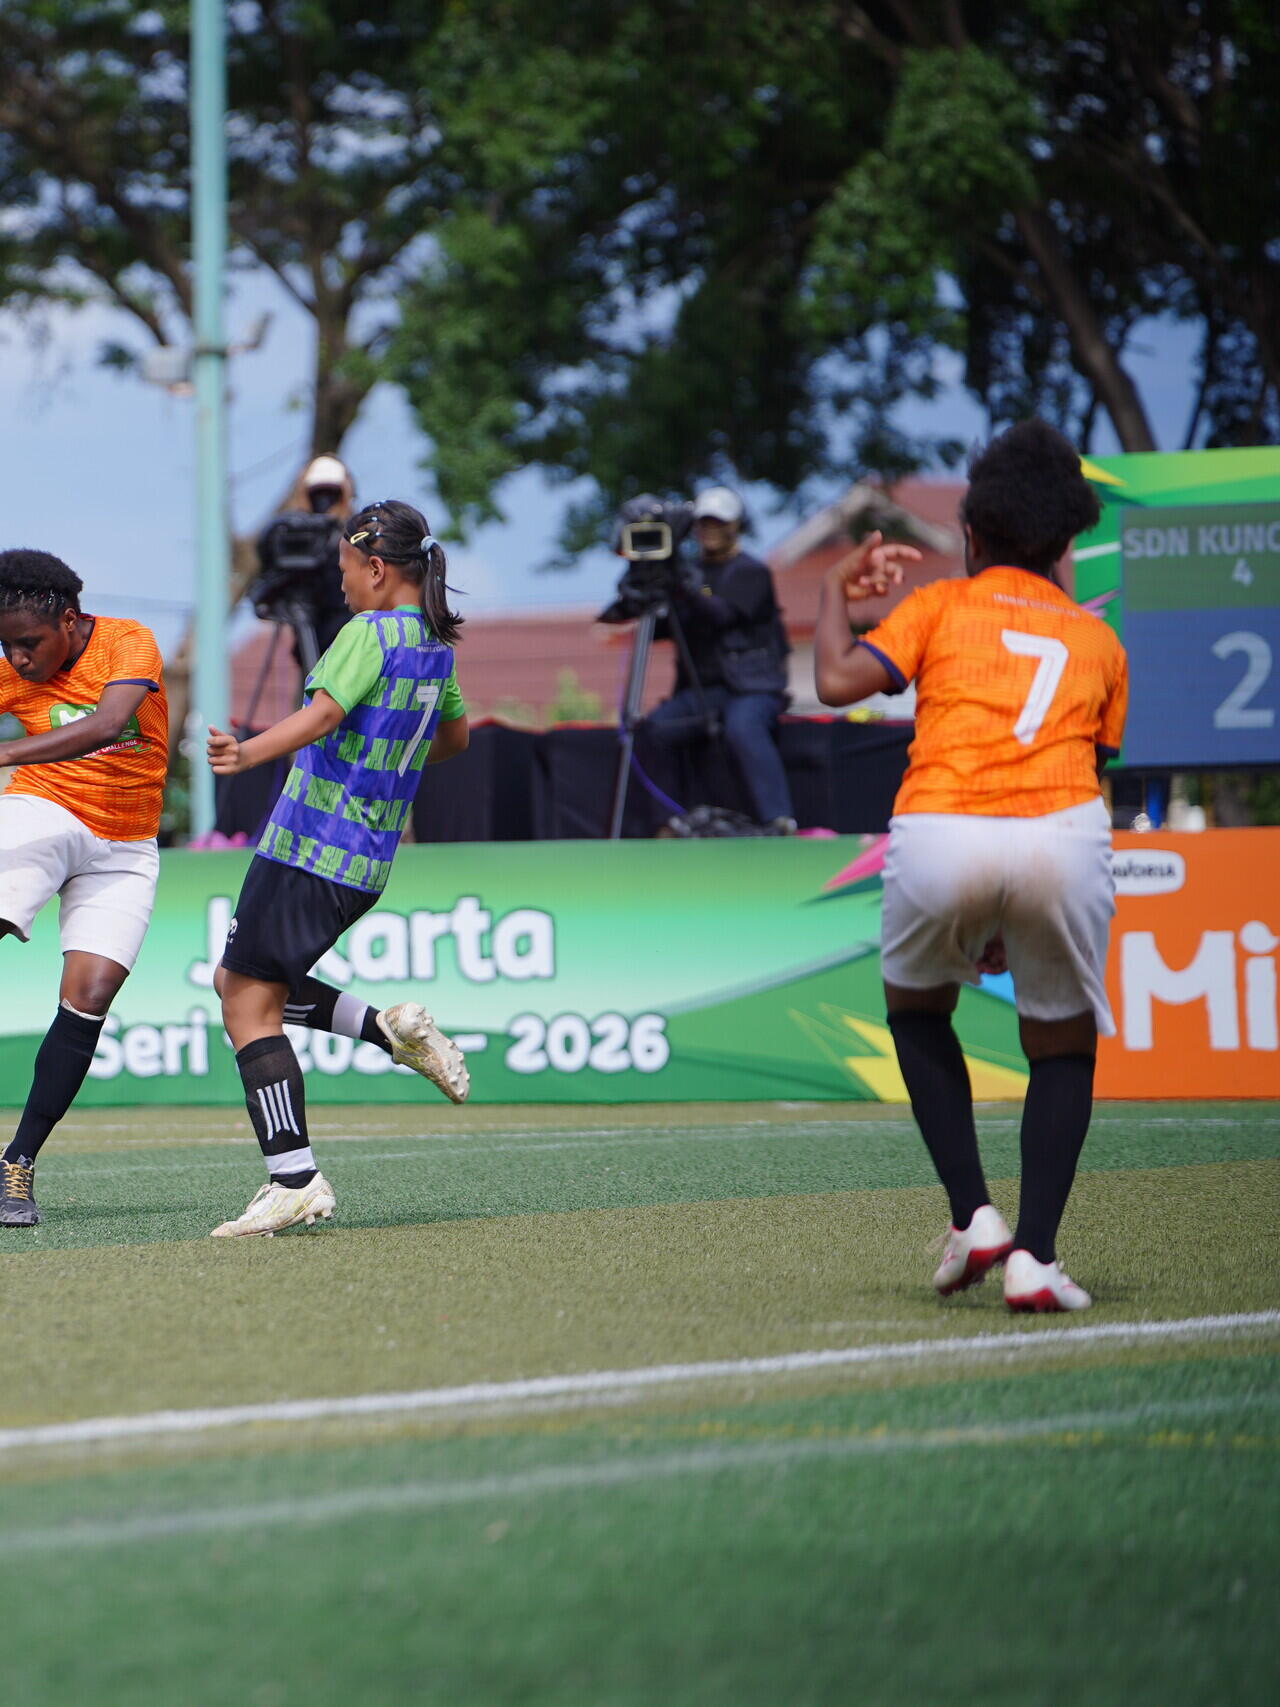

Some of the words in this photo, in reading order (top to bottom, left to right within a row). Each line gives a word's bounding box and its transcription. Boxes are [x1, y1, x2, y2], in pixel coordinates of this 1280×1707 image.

[1123, 526, 1189, 559] SDN
[1232, 558, 1254, 588] 4
[1001, 629, 1069, 746] 7
[1211, 631, 1275, 729] 2
[397, 685, 440, 778] 7
[188, 896, 556, 984] Jarta
[89, 1008, 209, 1079] Seri
[505, 1012, 669, 1075] 2026
